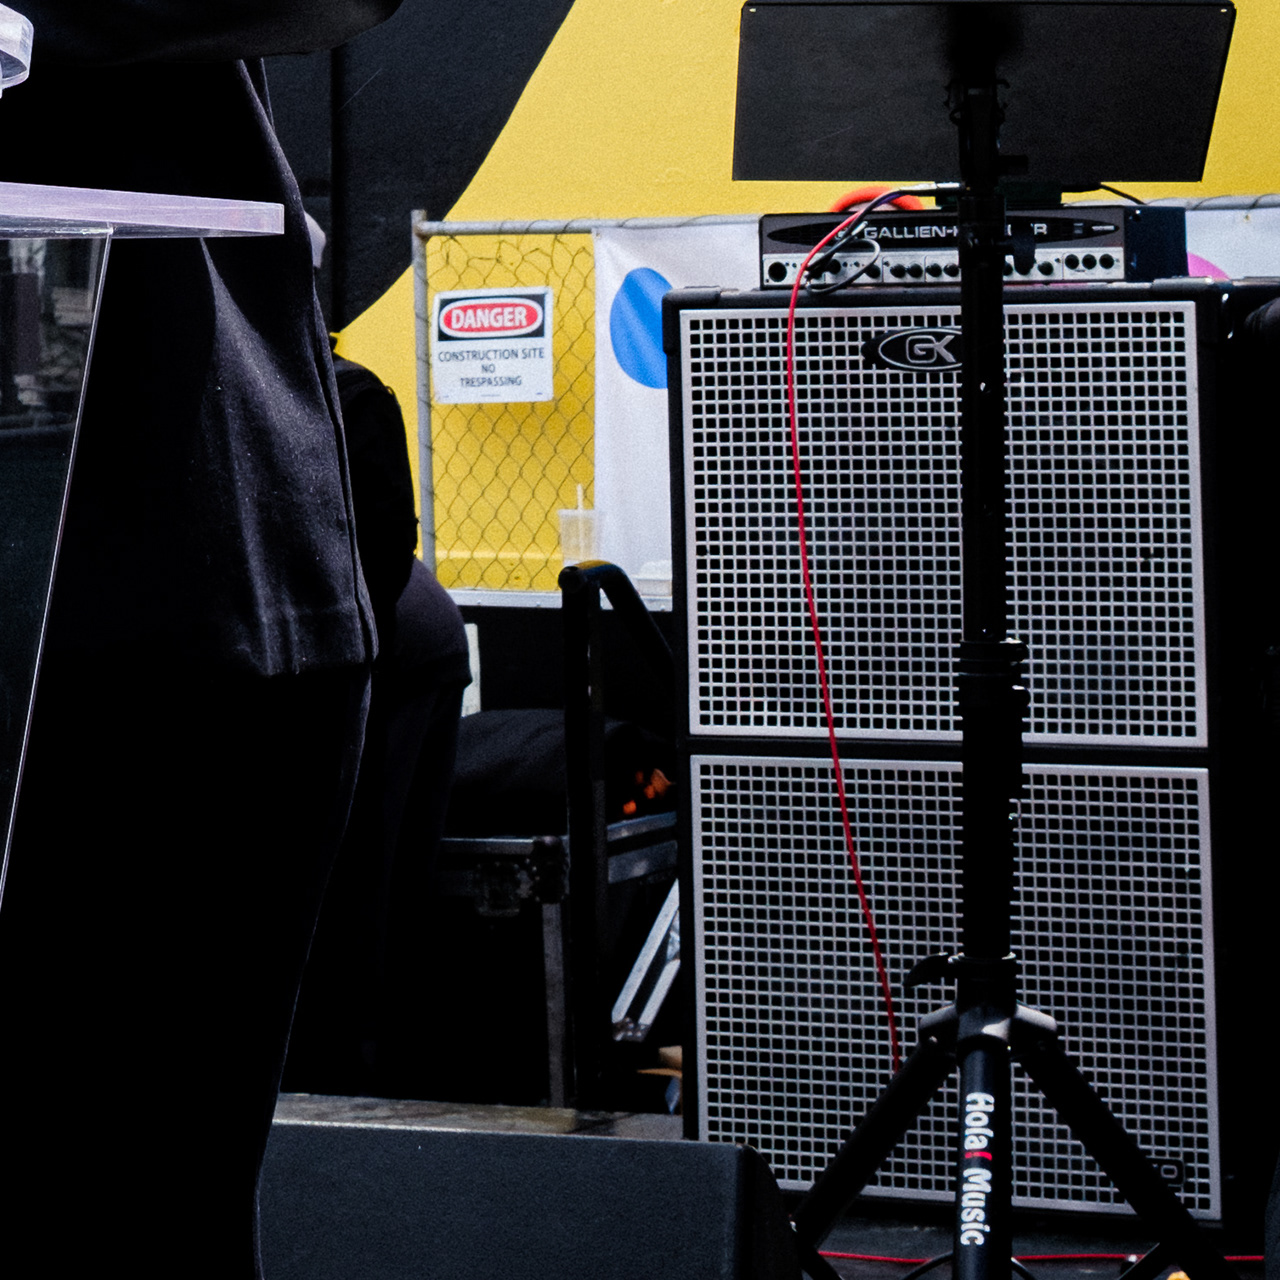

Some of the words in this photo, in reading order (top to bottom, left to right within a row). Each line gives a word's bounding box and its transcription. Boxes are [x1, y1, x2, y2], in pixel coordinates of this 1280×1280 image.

[451, 306, 528, 329] DANGER
[438, 349, 518, 362] CONSTRUCTION
[521, 347, 545, 359] SITE
[906, 334, 957, 363] GK
[481, 363, 496, 374] NO
[460, 376, 522, 387] TRESPASSING
[960, 1167, 993, 1246] Music
